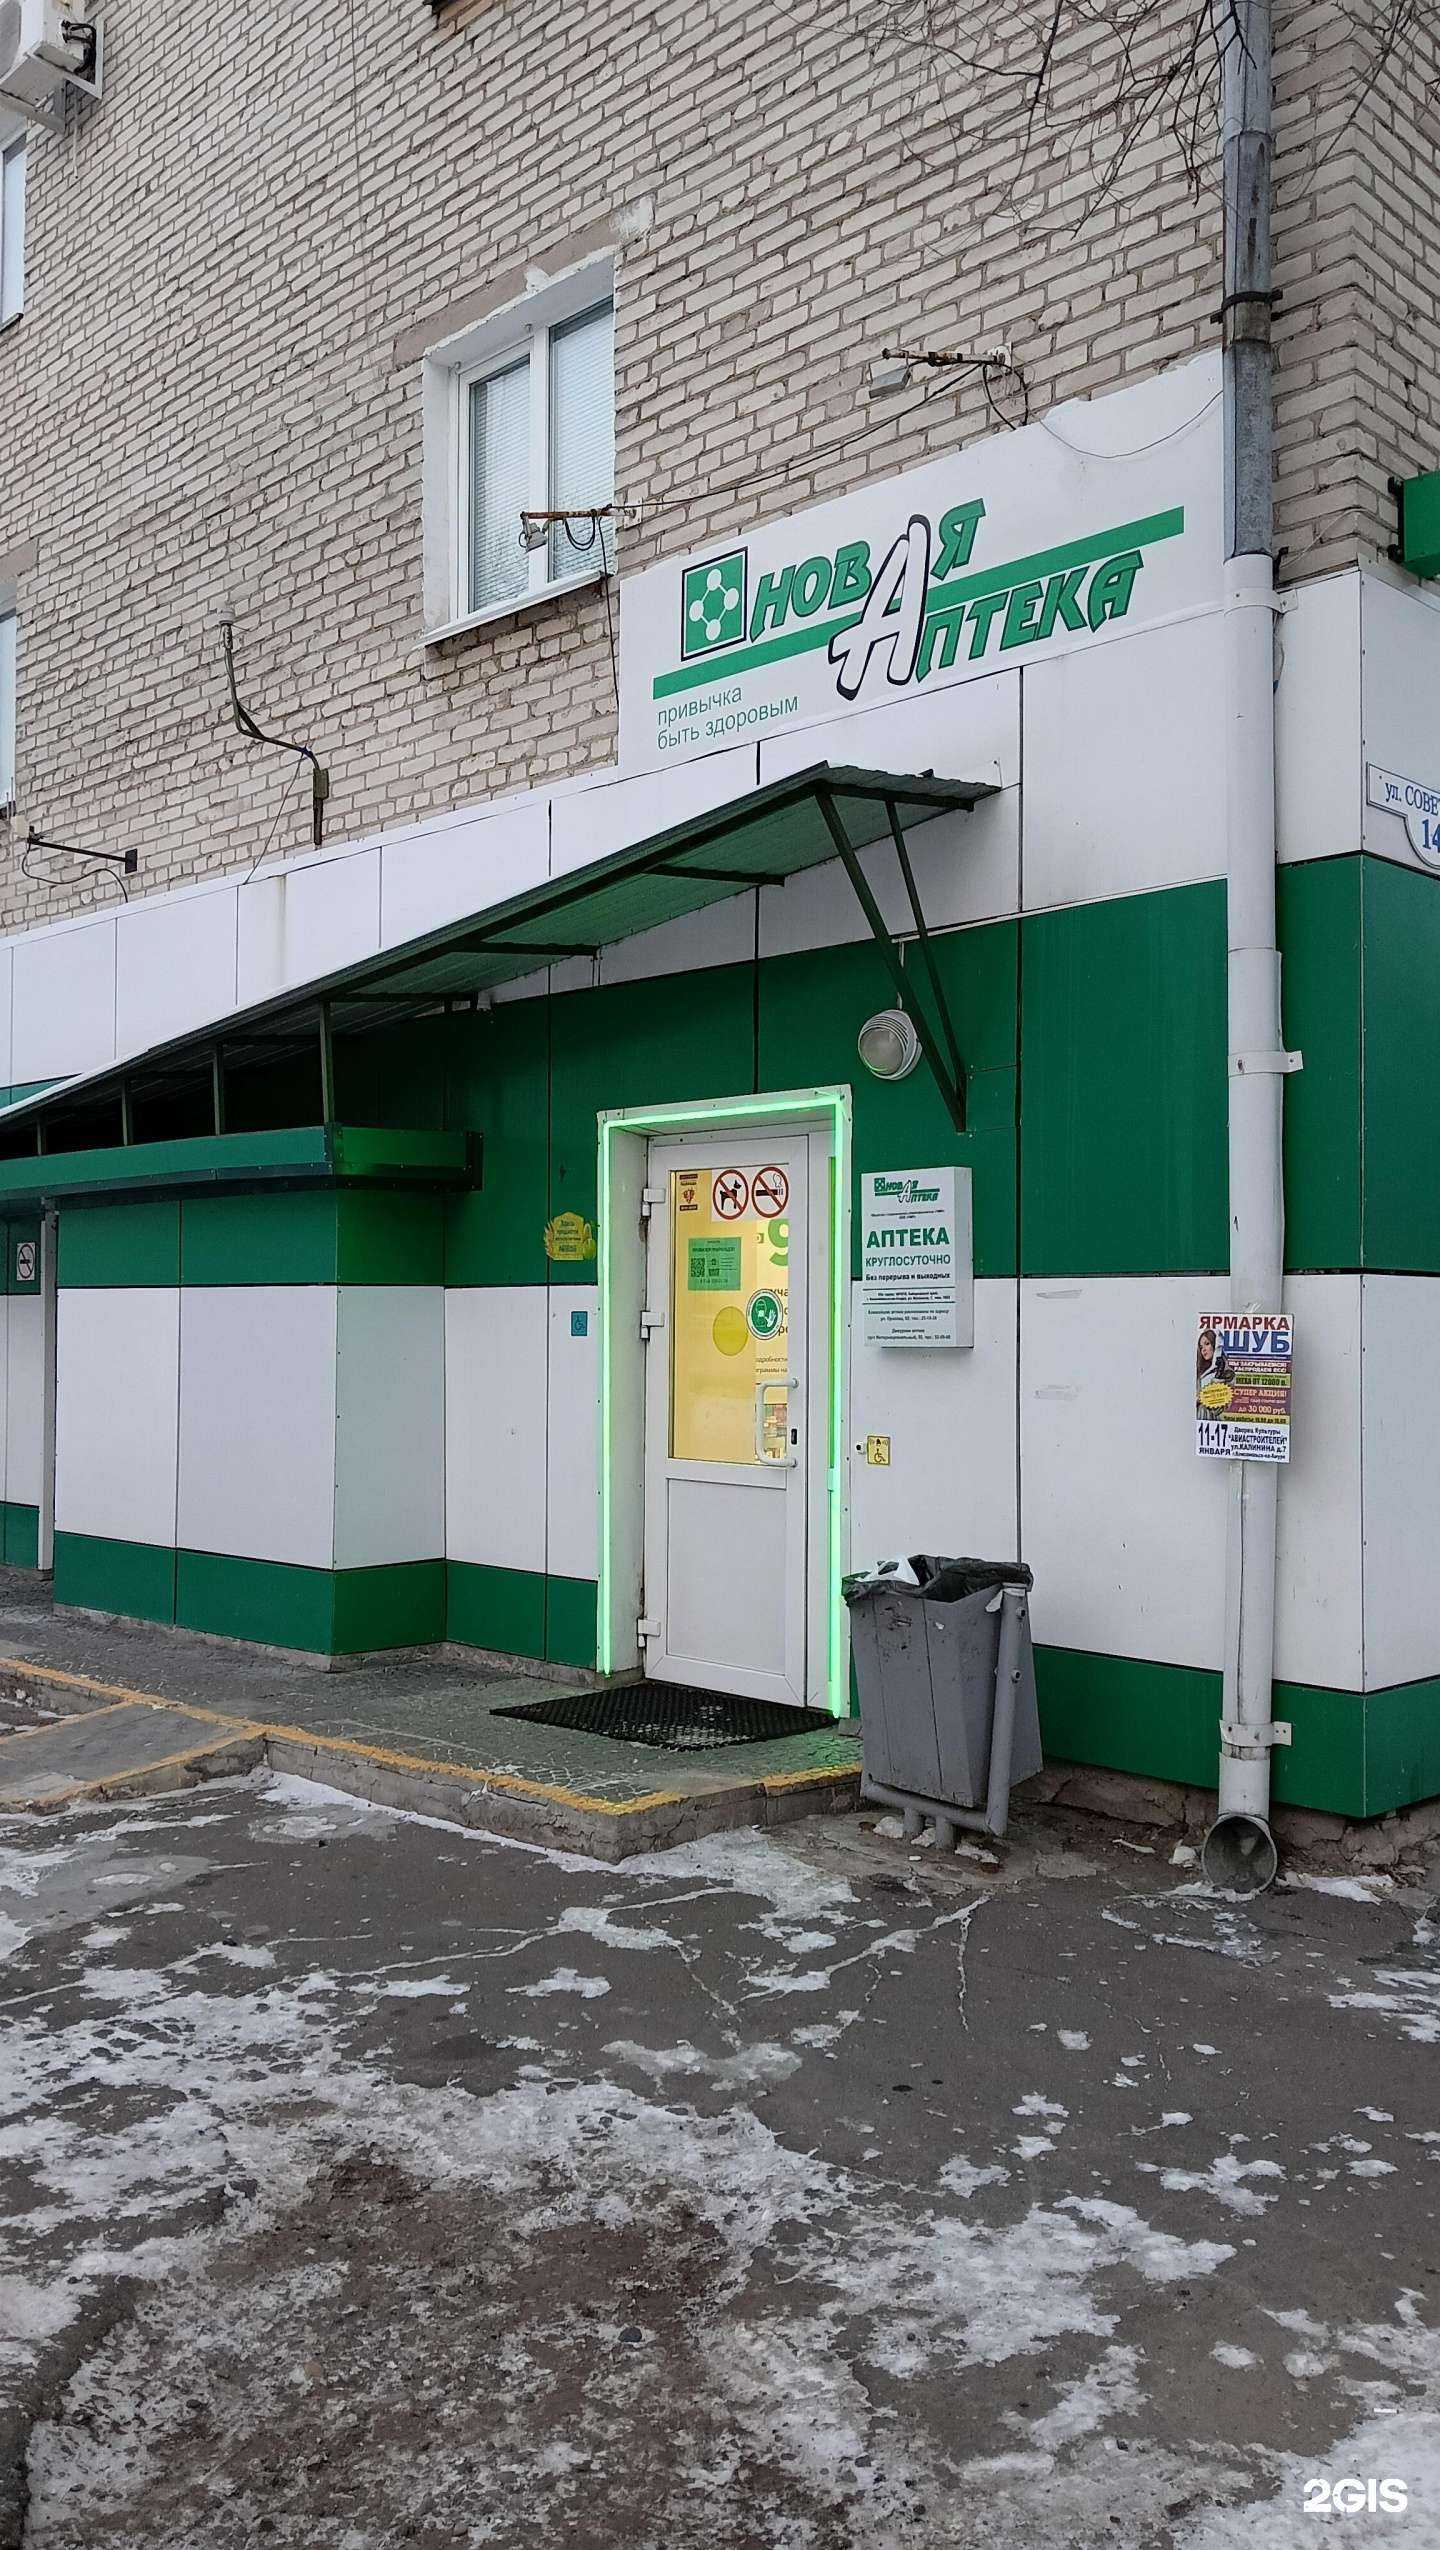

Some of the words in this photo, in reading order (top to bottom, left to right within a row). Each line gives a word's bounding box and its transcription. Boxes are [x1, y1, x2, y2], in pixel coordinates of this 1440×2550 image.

[658, 687, 742, 727] привычка
[657, 727, 700, 750] быть
[705, 696, 798, 737] здоровым
[1385, 783, 1402, 802] ул.
[1405, 785, 1440, 816] СОВЕ
[866, 1227, 950, 1248] АПТЕКА
[865, 1254, 951, 1267] КРУГЛОСУТОЧНО
[866, 1273, 877, 1281] Без
[1199, 1315, 1290, 1330] ЯРМАРКА
[1223, 1330, 1290, 1353] ШУБ
[1233, 1388, 1257, 1396] СУПЕР
[1198, 1422, 1228, 1447] 11-17
[1199, 1447, 1231, 1455] ЯНВАРЯ
